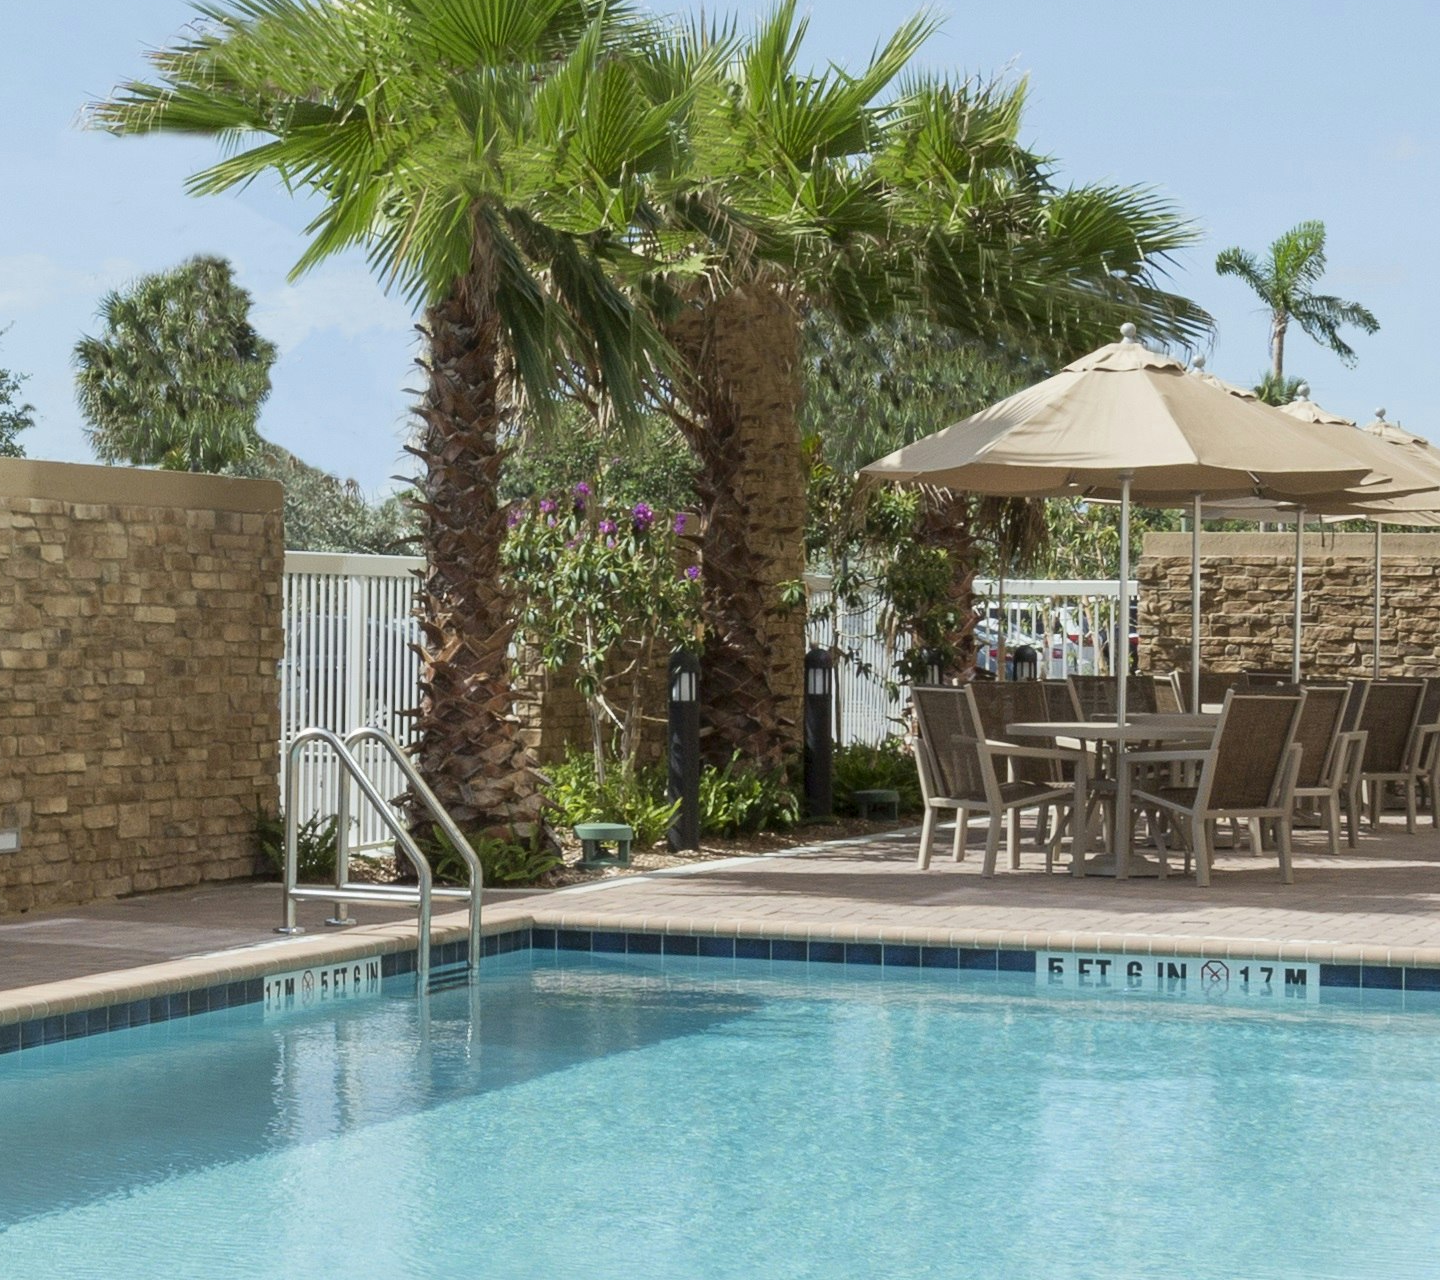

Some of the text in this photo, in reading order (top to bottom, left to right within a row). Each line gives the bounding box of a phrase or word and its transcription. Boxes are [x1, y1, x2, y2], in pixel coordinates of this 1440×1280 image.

[1078, 958, 1112, 976] FT
[1157, 962, 1187, 979] IN
[1285, 968, 1307, 985] M
